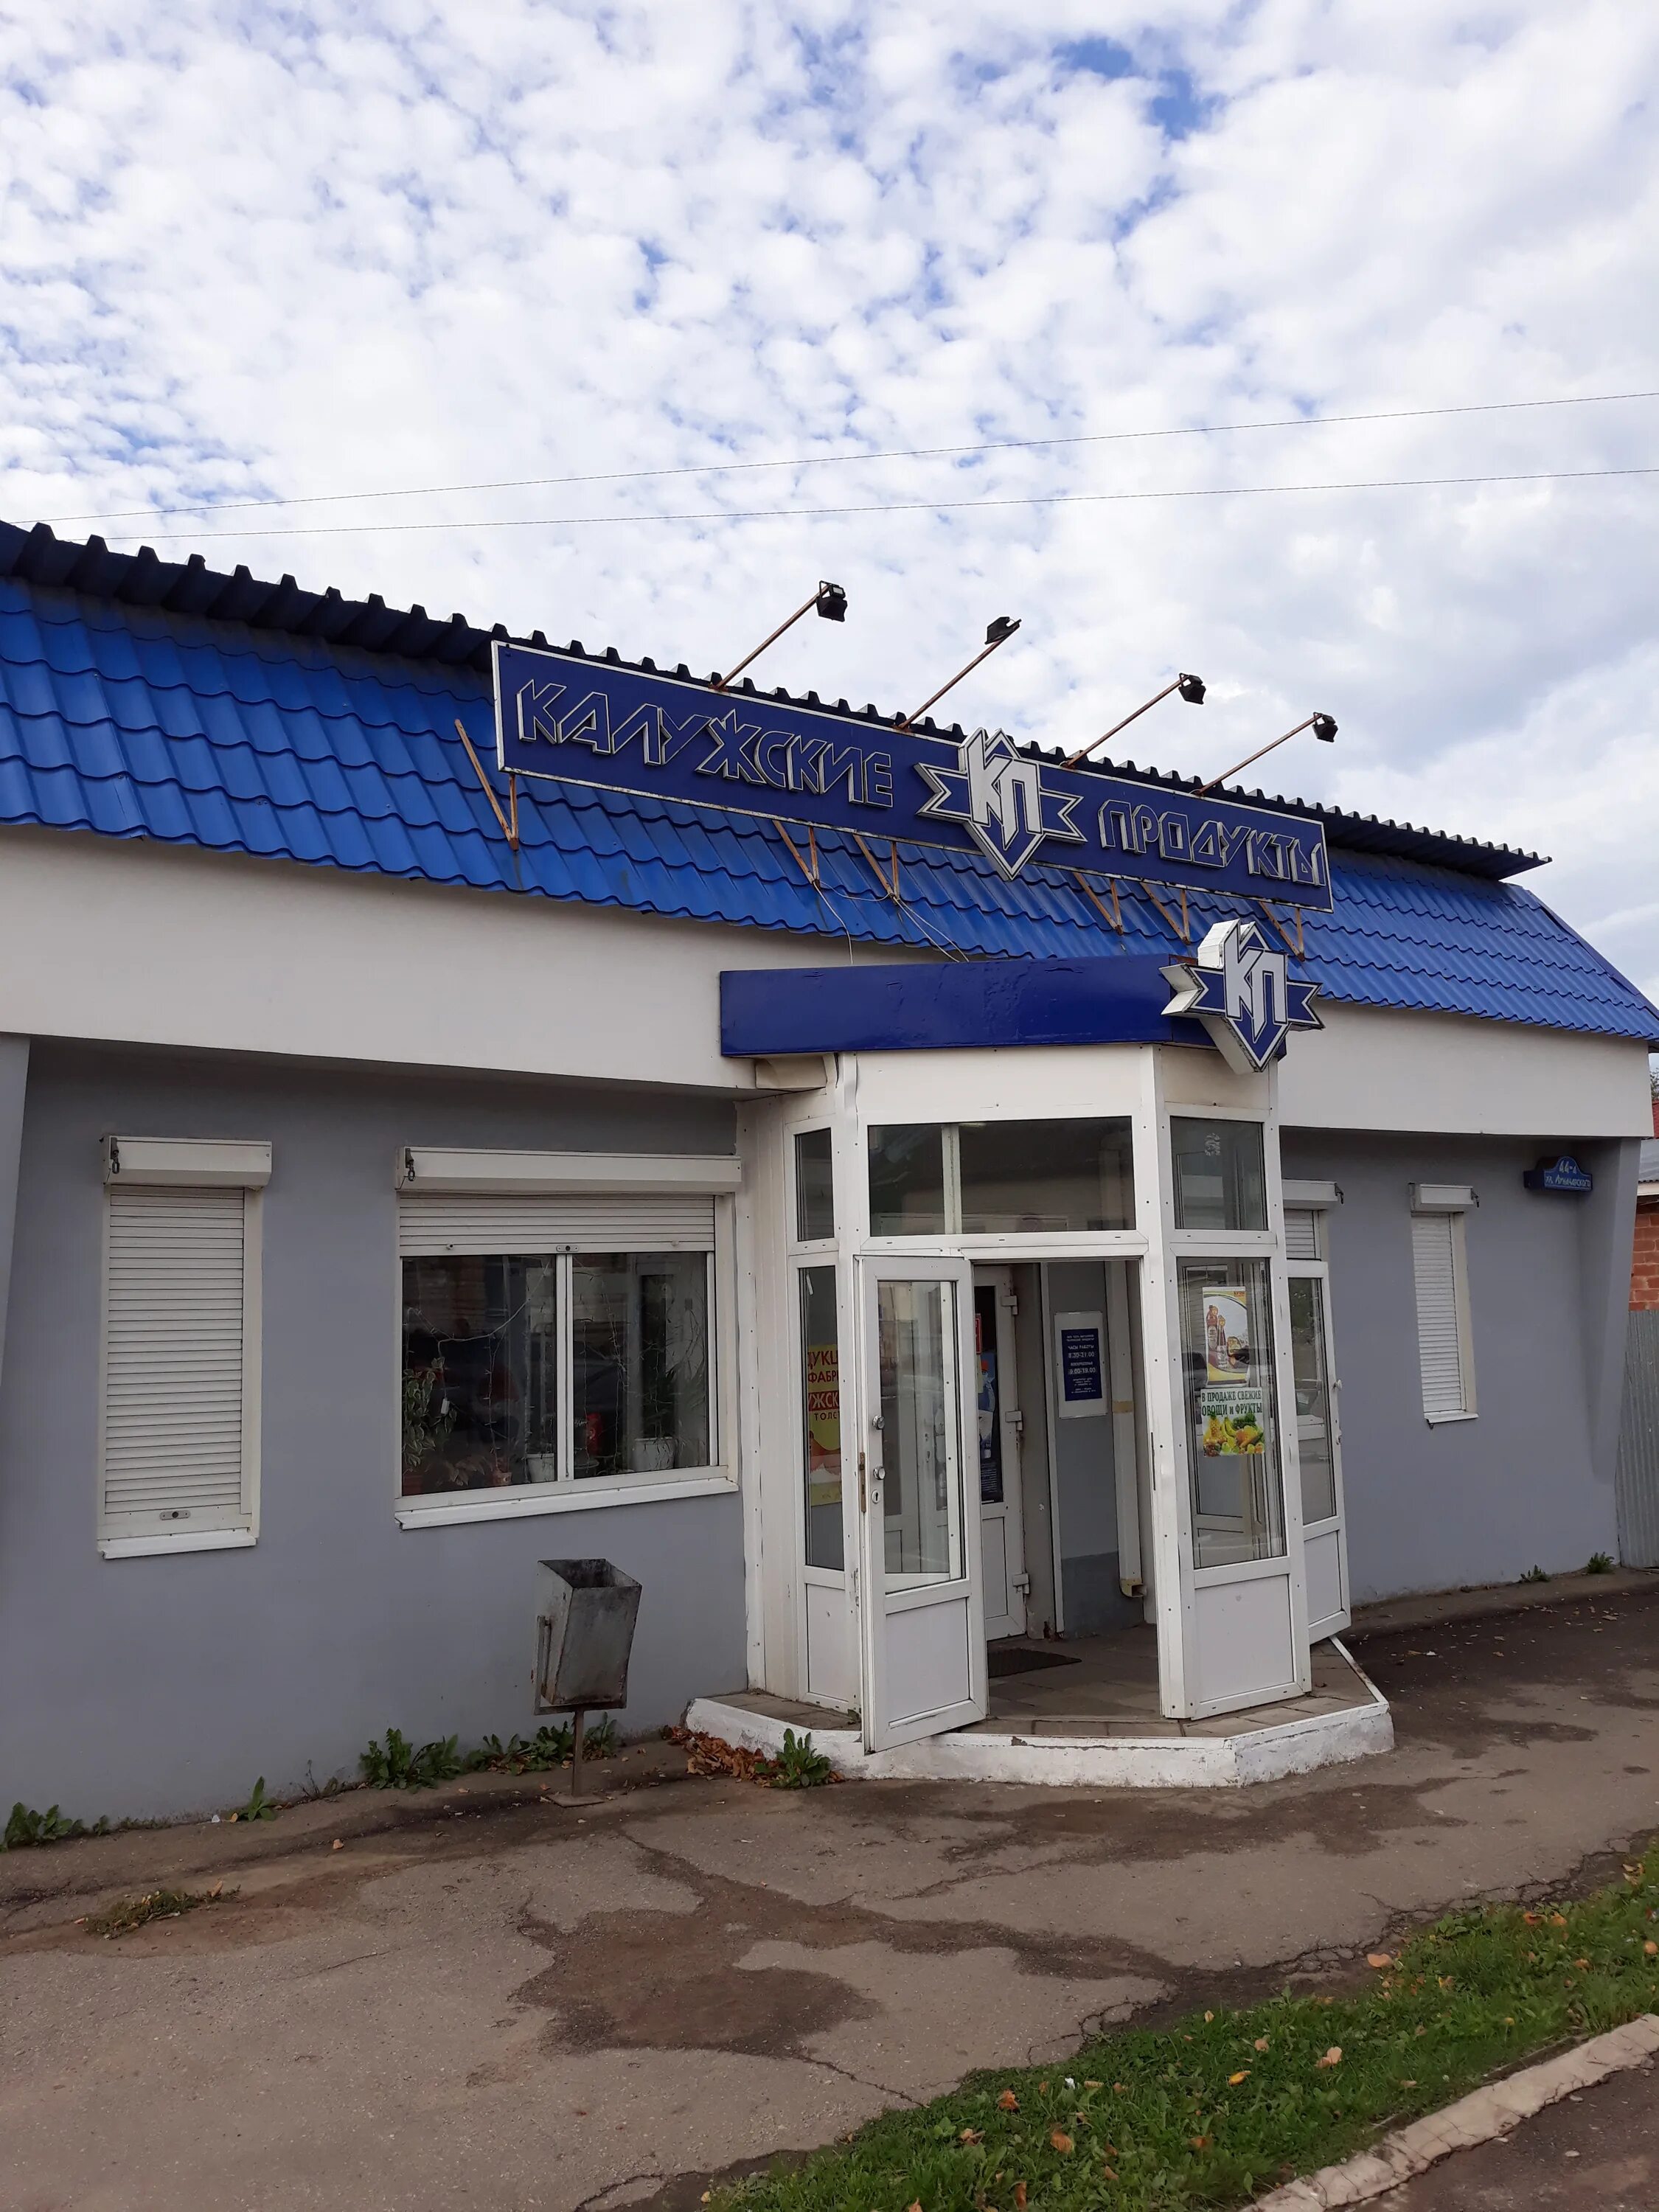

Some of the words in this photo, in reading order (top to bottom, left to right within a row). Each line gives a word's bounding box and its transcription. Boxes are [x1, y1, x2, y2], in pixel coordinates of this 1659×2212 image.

[517, 679, 893, 808] КАЛУЖСКИЕ
[1098, 799, 1326, 886] ПРОДУКТЫ
[964, 727, 1043, 851] КП
[1222, 922, 1288, 1044] КП
[808, 1370, 839, 1383] ФАБР
[1201, 1393, 1206, 1402] В
[1207, 1391, 1237, 1403] ПРОДАЖЕ
[1237, 1390, 1262, 1400] СВЕЖИЕ
[1201, 1404, 1228, 1417] ОВОЩИ
[1235, 1402, 1262, 1414] ФРУКТЫ
